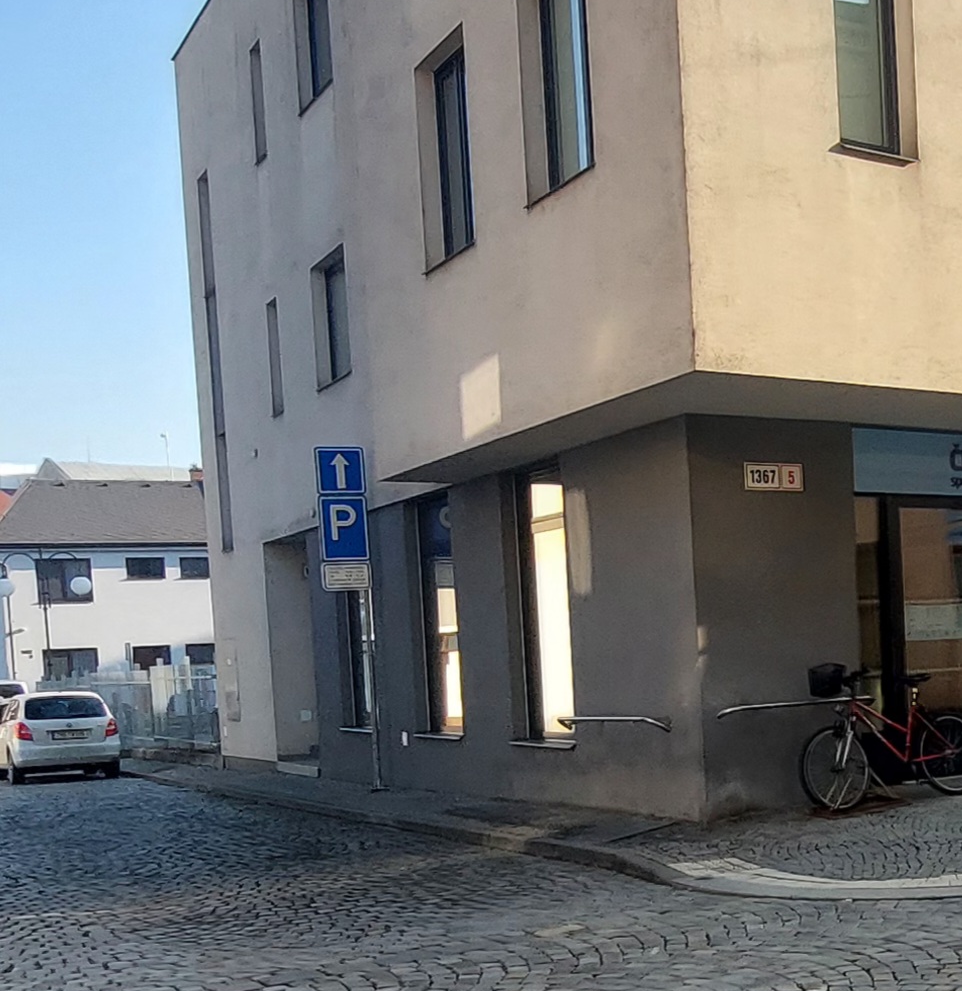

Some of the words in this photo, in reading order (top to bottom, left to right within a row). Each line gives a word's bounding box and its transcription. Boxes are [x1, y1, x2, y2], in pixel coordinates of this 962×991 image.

[749, 469, 776, 484] 1367
[787, 470, 796, 485] 5
[329, 504, 357, 541] P
